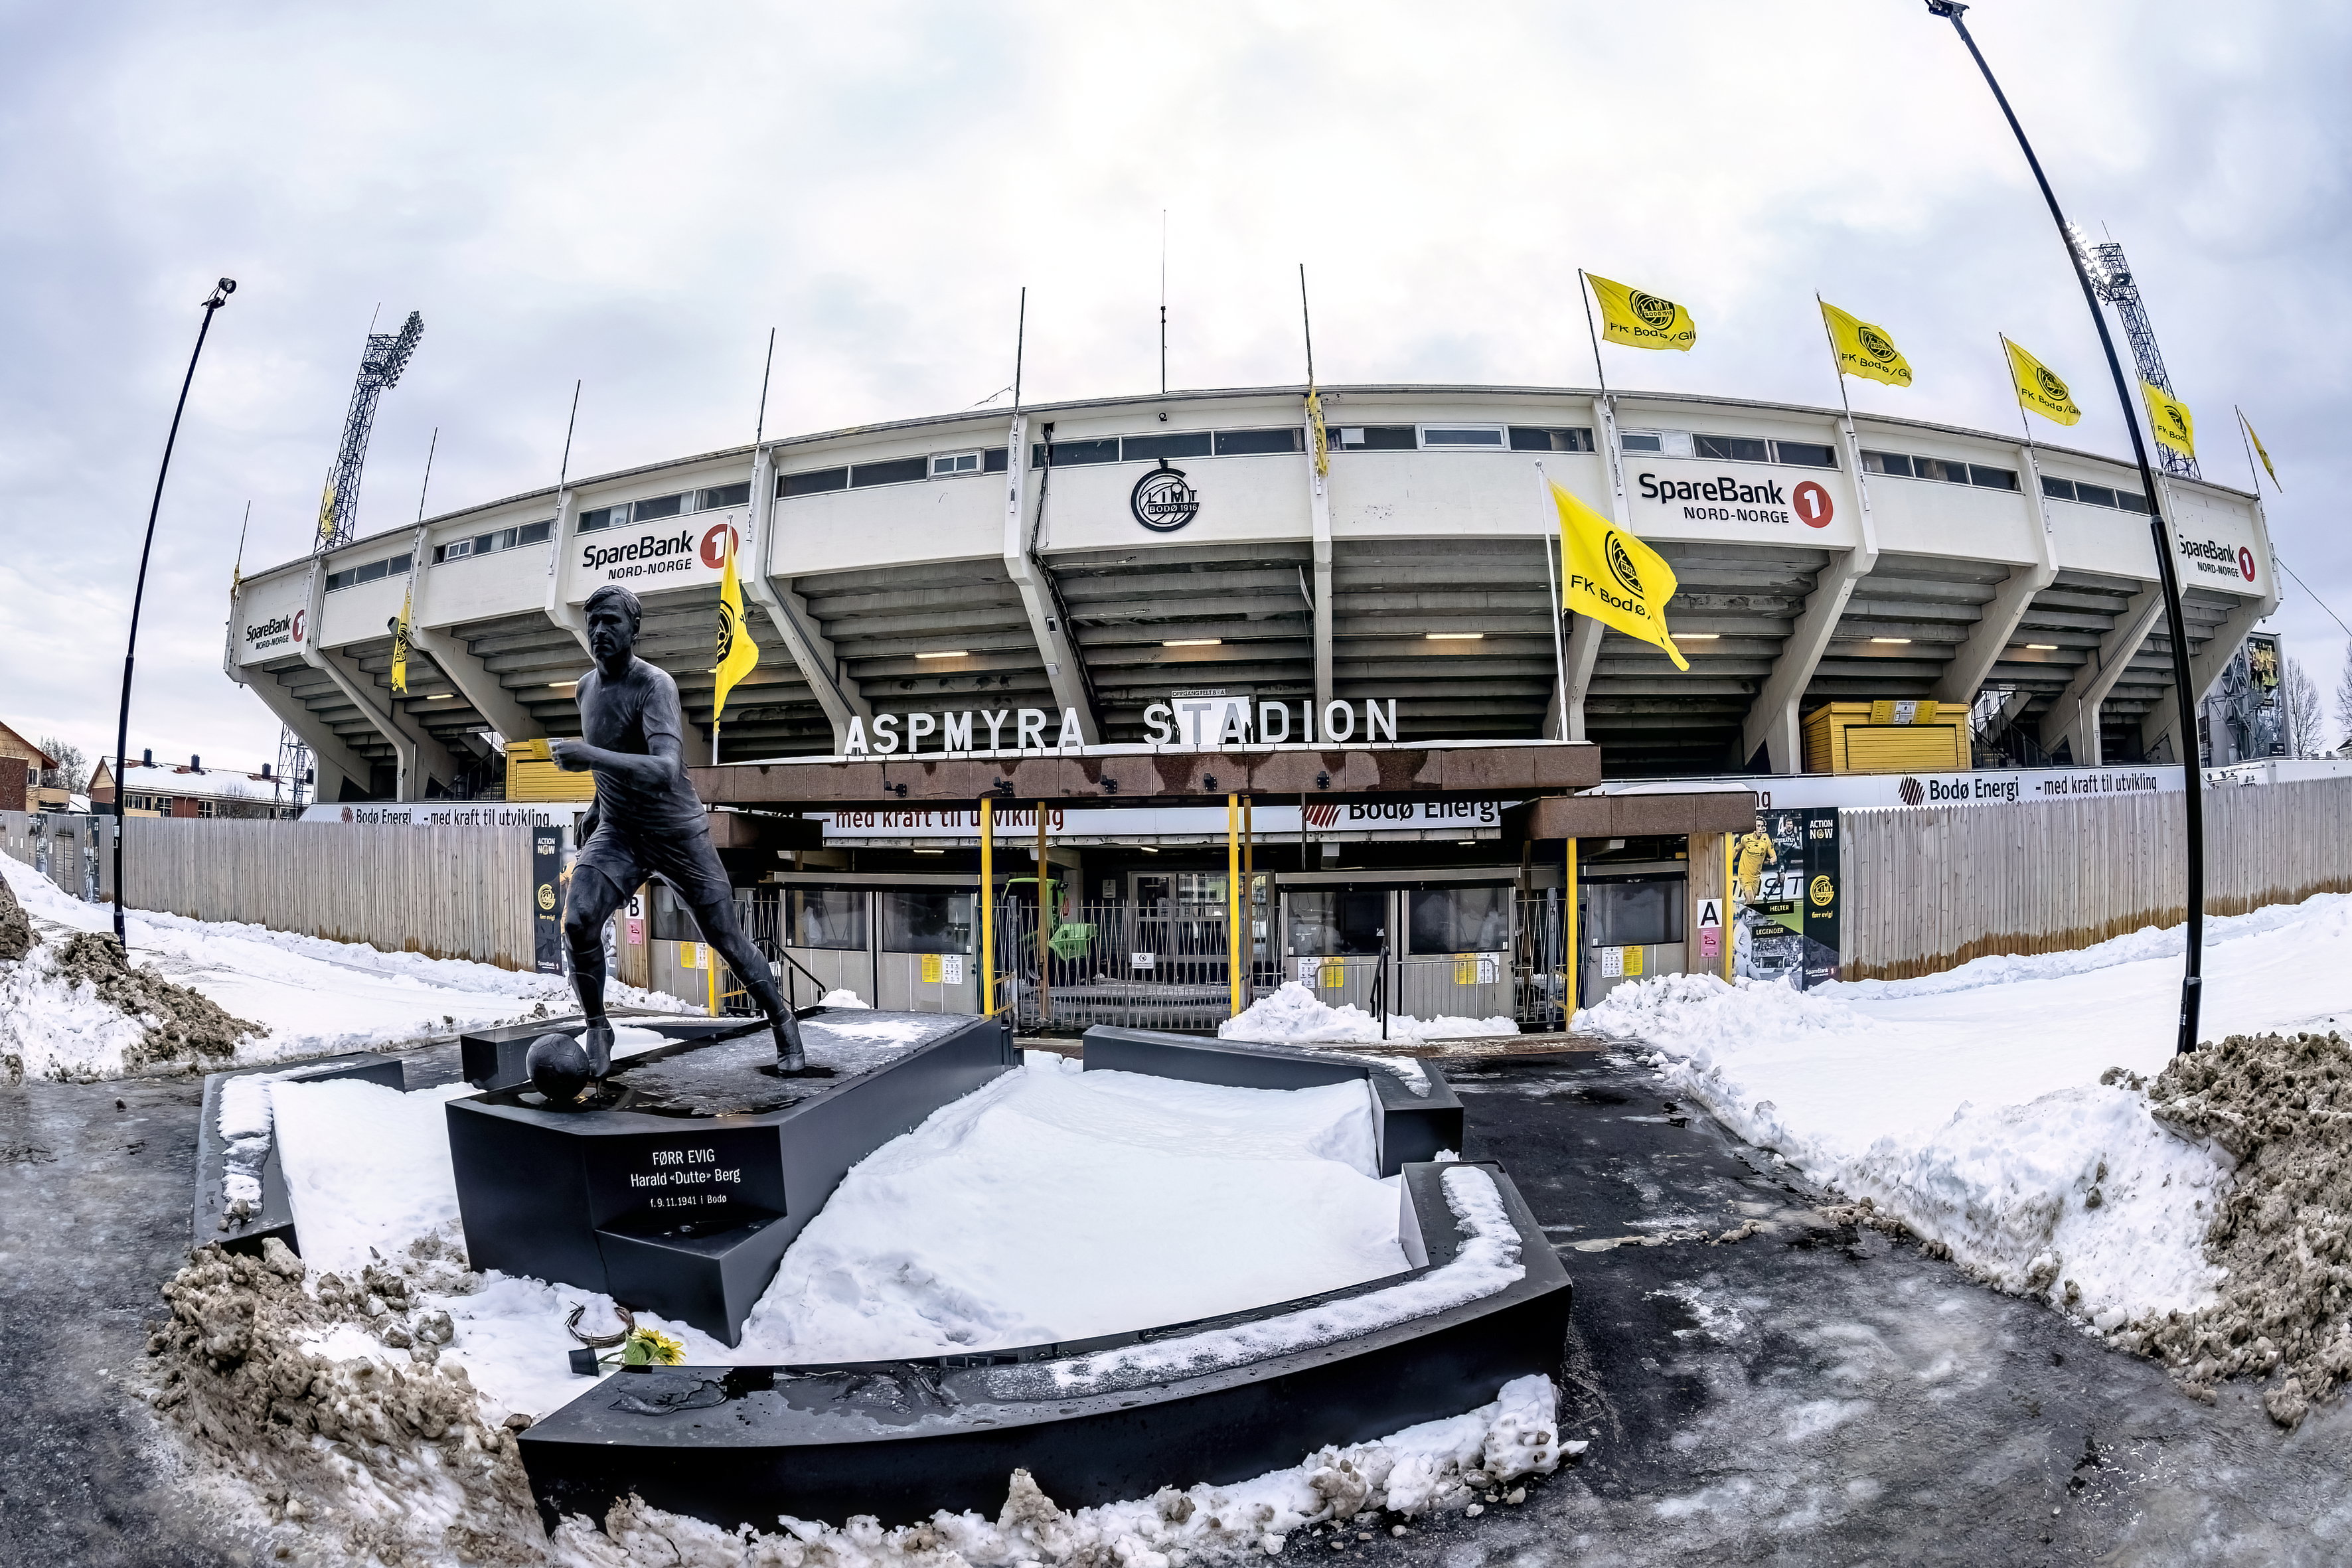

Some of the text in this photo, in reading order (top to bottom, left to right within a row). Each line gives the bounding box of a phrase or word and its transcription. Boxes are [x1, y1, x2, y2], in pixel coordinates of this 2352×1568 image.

[1610, 322, 1629, 333] FK
[1842, 353, 1856, 362] FK
[2022, 388, 2035, 400] FK
[1638, 473, 1786, 504] SpareBank
[1684, 507, 1790, 524] NORD-NORGE
[582, 530, 694, 570] SpareBank
[608, 558, 692, 580] NORD-NORGE
[2197, 562, 2239, 578] NORD-NORGE
[1571, 574, 1595, 595] FK
[246, 614, 291, 643] SpareBank
[256, 635, 289, 650] NORD-NORGE
[844, 699, 1396, 755] ASPMYRA STADION
[1930, 779, 1970, 800] Bodø
[1975, 776, 2019, 802] Energi
[2044, 776, 2068, 795] med
[2071, 774, 2098, 793] kraft
[2102, 773, 2112, 792] til
[2116, 772, 2157, 793] utvikling
[356, 808, 379, 824] Bodø
[382, 808, 412, 825] Energi
[431, 809, 451, 824] med
[454, 809, 479, 825] kraft
[483, 809, 495, 826] til
[499, 808, 550, 827] utvikling
[836, 812, 874, 828] med
[883, 812, 932, 828] kraft
[1350, 803, 1414, 821] Bodø
[1810, 819, 1833, 828] ACTION
[630, 896, 639, 917] B
[1700, 902, 1719, 926] A
[653, 1148, 715, 1166] FØRR EVIG
[631, 1168, 741, 1187] Harald «Dutte» Berg
[700, 1196, 703, 1204] i
[707, 1194, 727, 1204] Bodø
